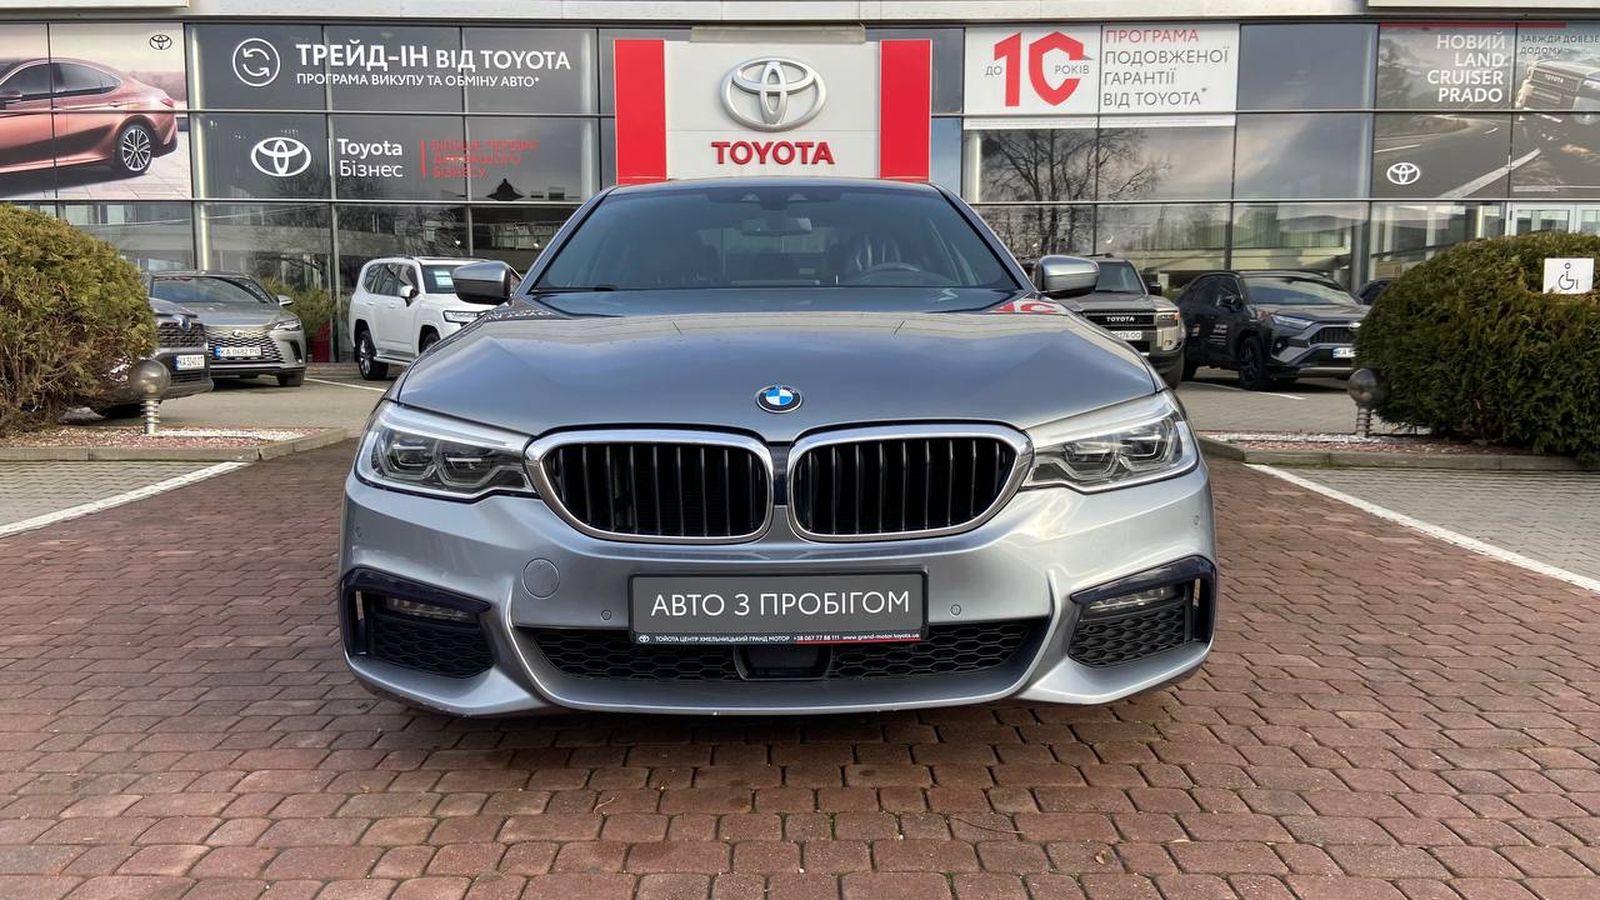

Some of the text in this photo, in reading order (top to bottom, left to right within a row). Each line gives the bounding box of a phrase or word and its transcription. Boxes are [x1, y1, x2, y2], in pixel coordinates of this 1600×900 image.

[1105, 29, 1199, 43] ПРОГРАМА
[1437, 32, 1505, 49] НОВИЙ
[295, 39, 571, 73] ТРЕЙД-ІН ВІД TOYOTA
[1105, 45, 1230, 67] ПОДОВЖЕНОЇ
[1455, 52, 1504, 67] LAND
[985, 66, 1002, 77] ДО
[1055, 65, 1090, 75] РОКІВ
[1104, 67, 1176, 85] ГАРАНТІЇ
[1427, 69, 1504, 85] CRUISER
[296, 73, 369, 85] ПРОГРАМА
[371, 74, 424, 86] ВИКУПУ
[427, 75, 443, 86] ТА
[445, 75, 498, 87] ОБМІНУ
[1103, 92, 1131, 109] ВІД
[1438, 87, 1503, 103] PRADO
[337, 138, 403, 160] Toyota
[711, 140, 836, 166] TOYOTA
[340, 159, 404, 177] Бізнес
[651, 593, 725, 617] АВТО
[760, 590, 910, 616] ПРОБІГОМ
